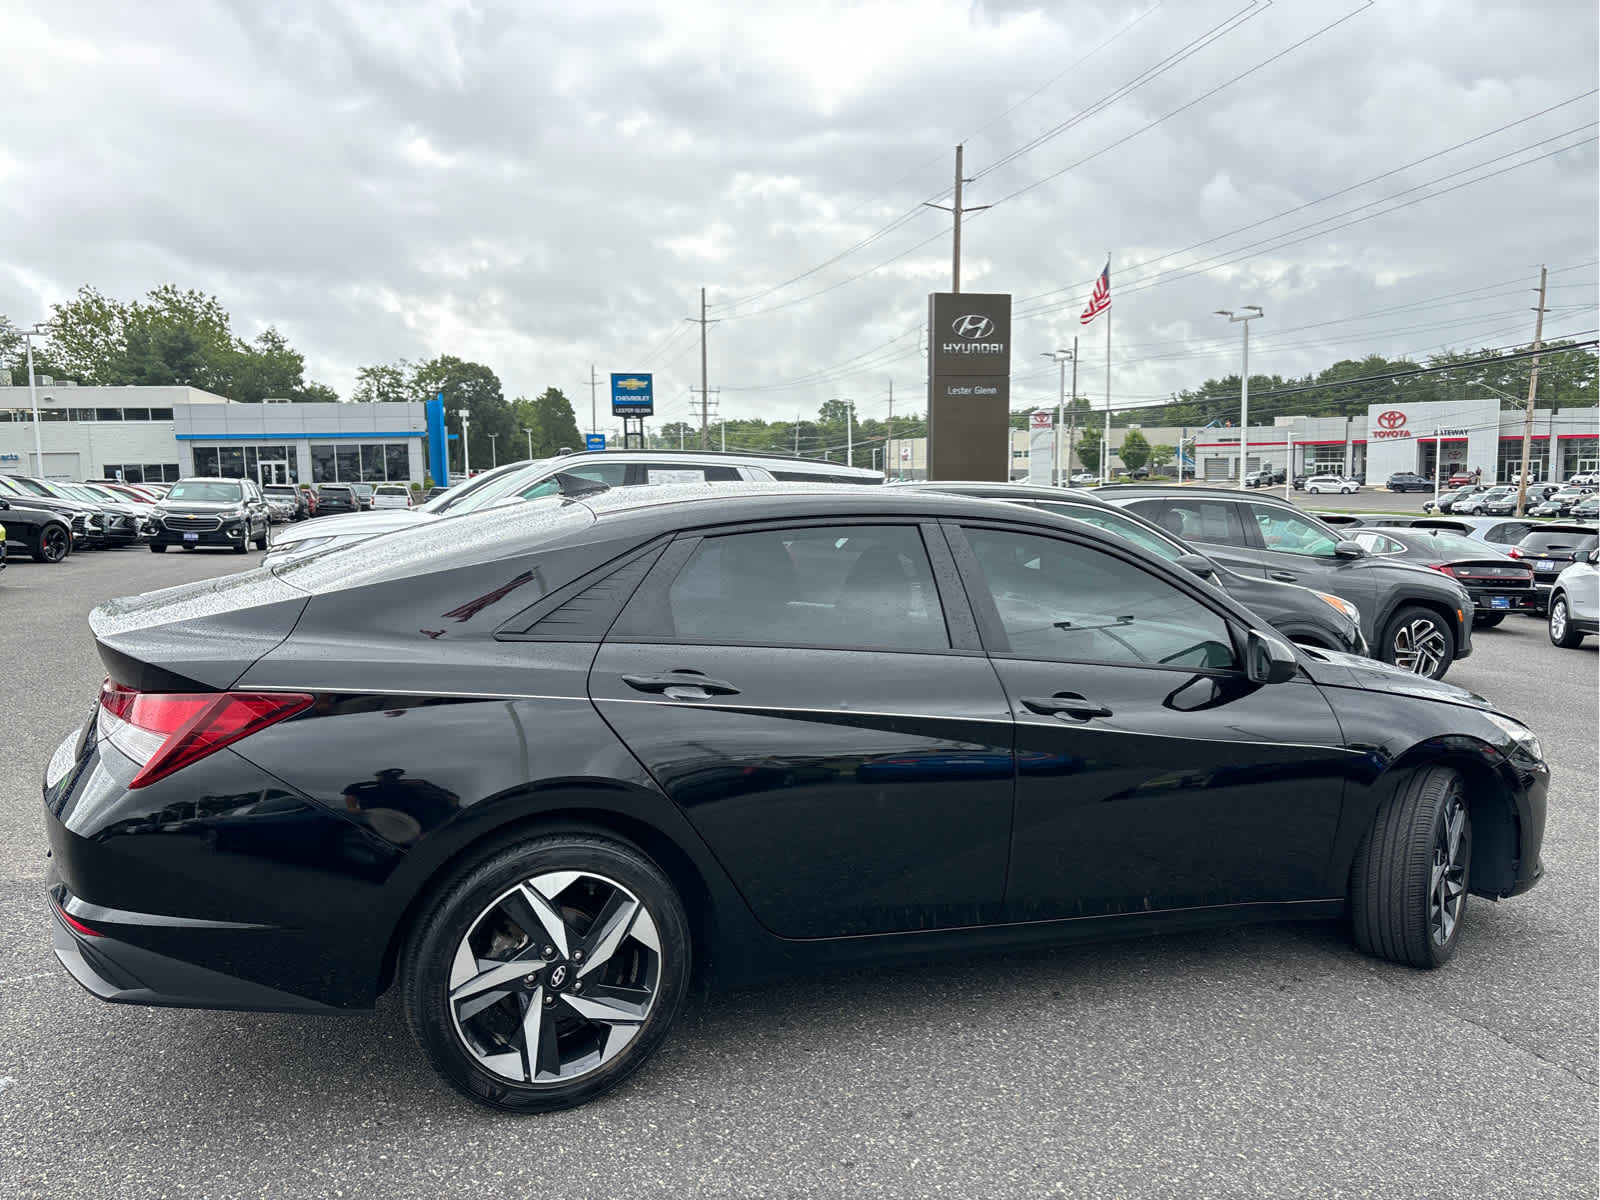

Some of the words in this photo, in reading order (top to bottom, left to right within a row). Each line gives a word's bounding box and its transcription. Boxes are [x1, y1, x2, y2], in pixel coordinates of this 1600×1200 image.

[943, 343, 1003, 354] HYUNDAI
[947, 385, 972, 394] Lester
[974, 386, 997, 394] Glenn
[1372, 430, 1411, 438] TOYOTA
